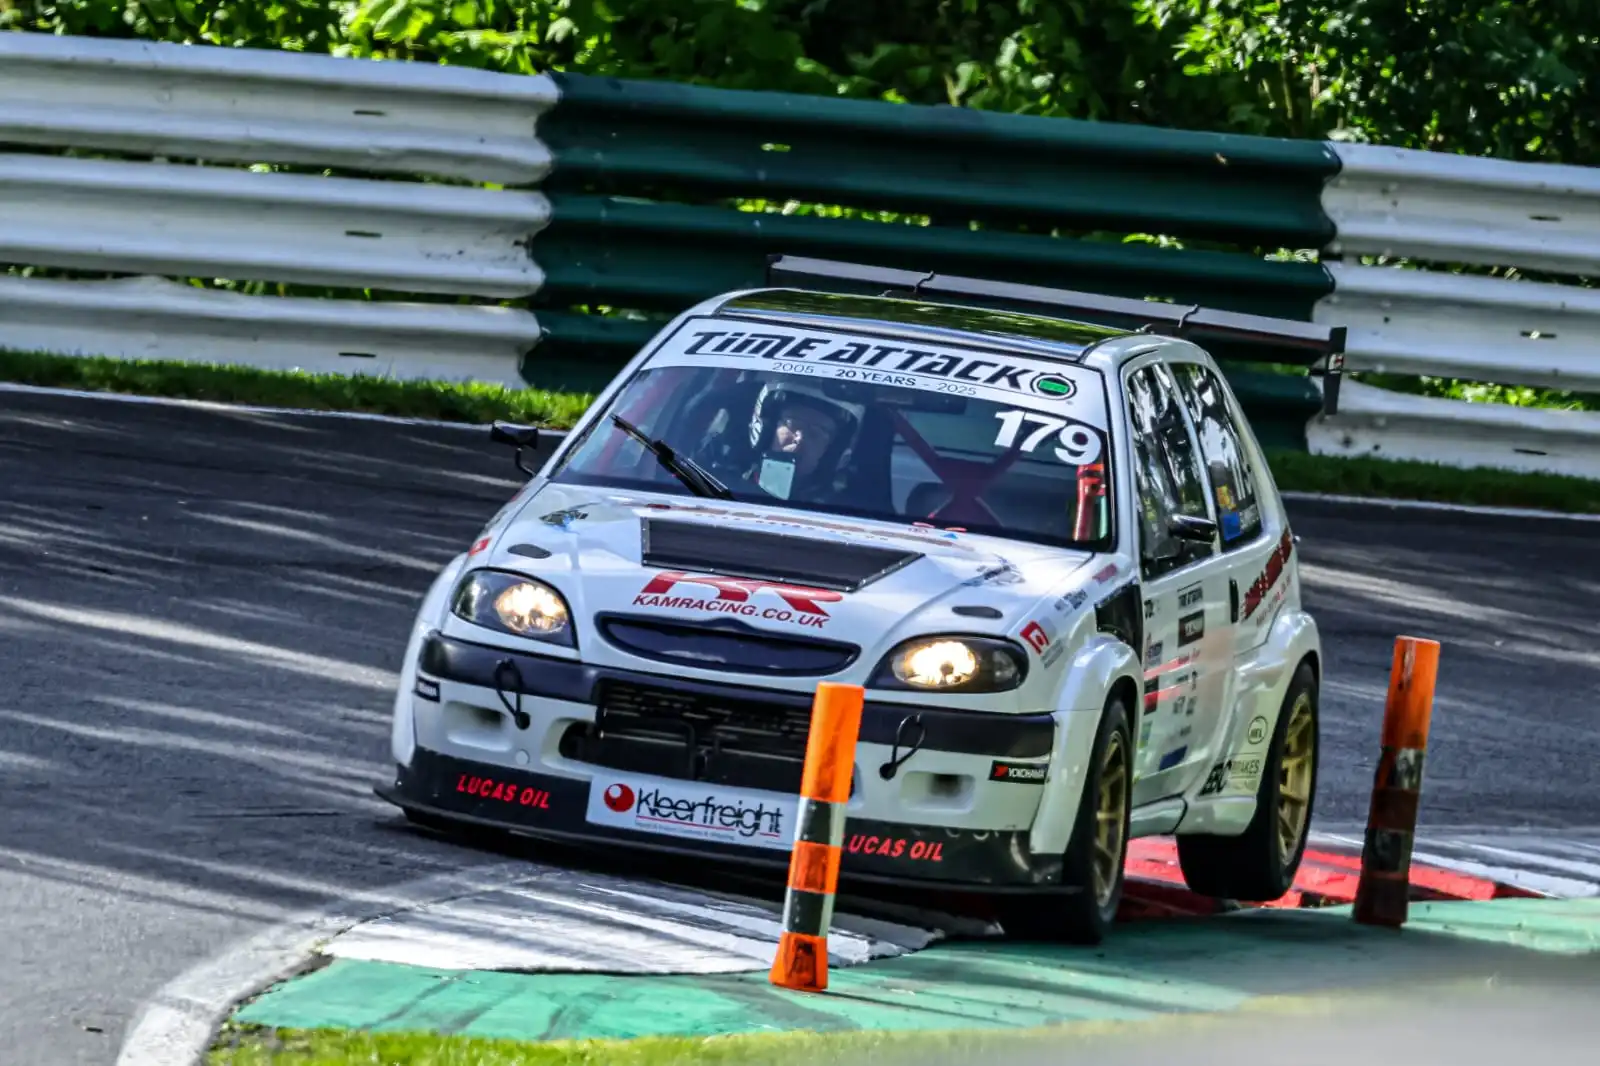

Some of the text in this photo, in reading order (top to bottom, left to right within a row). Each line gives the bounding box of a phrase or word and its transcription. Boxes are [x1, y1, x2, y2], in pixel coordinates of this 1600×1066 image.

[772, 362, 814, 374] 2005
[835, 368, 857, 379] 20
[861, 370, 917, 386] YEARS
[936, 382, 977, 396] 2025
[993, 410, 1101, 465] 179
[632, 594, 831, 629] KAMRACING.CO.UK
[456, 774, 551, 809] LUCAS OIL
[636, 787, 784, 837] Kleerfreight
[842, 833, 943, 862] UCAS OIL
